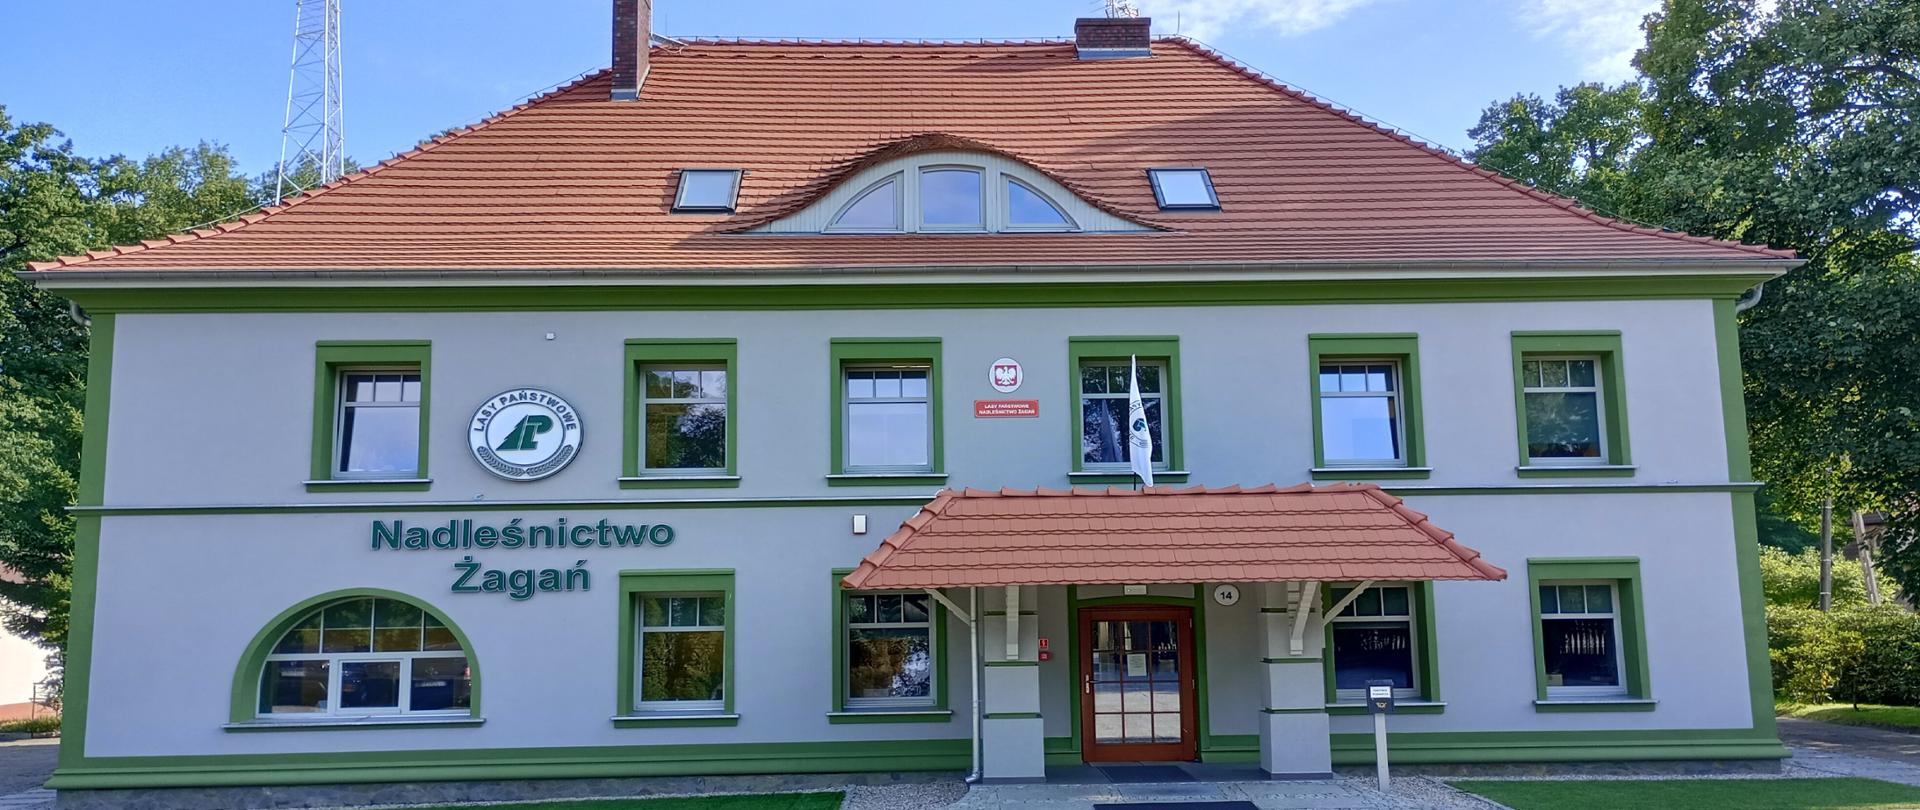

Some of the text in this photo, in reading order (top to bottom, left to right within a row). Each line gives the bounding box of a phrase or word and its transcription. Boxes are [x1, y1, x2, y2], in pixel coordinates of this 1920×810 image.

[474, 390, 576, 432] LASY PAŃSTWOWE
[371, 517, 675, 551] Nadleśnictwo
[451, 555, 591, 600] Żagań
[1220, 591, 1232, 600] 14
